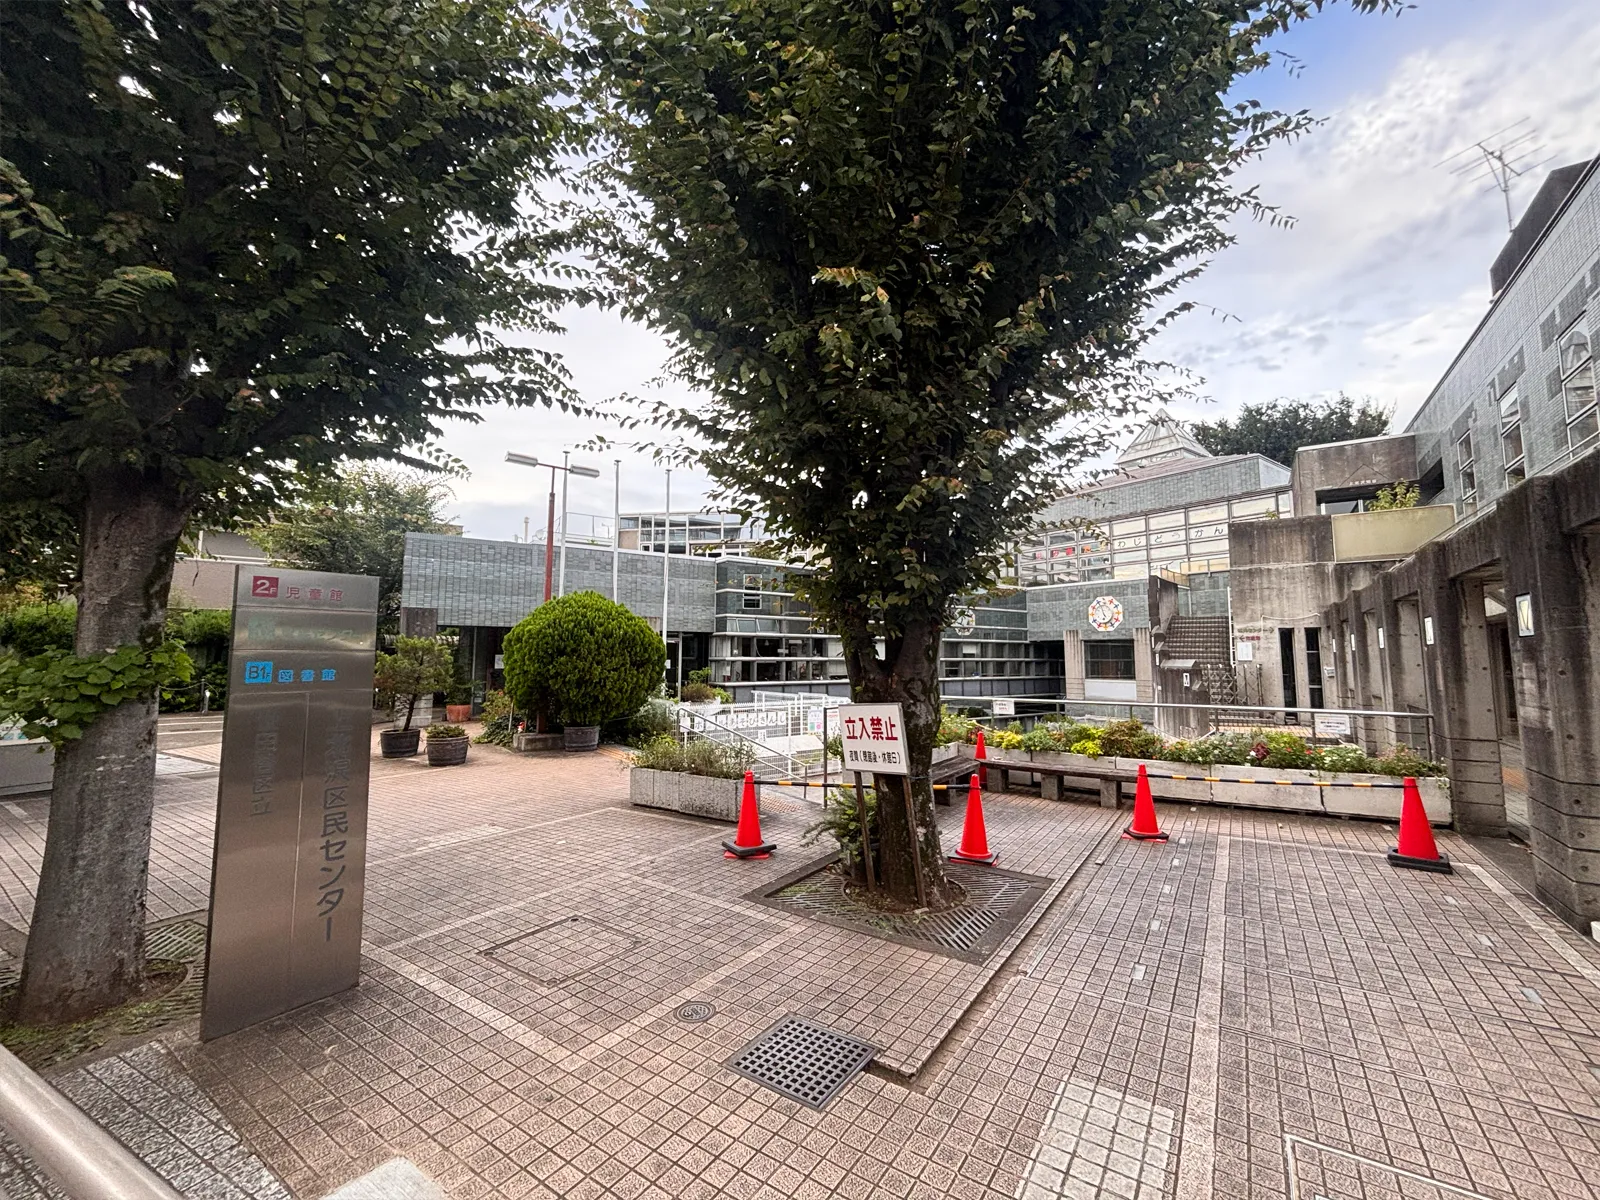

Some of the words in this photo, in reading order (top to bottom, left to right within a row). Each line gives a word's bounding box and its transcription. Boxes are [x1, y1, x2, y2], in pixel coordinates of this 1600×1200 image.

[255, 579, 277, 595] 2F
[286, 586, 344, 602] 児童館
[278, 668, 337, 683] 図書館
[844, 716, 899, 741] 立入禁止
